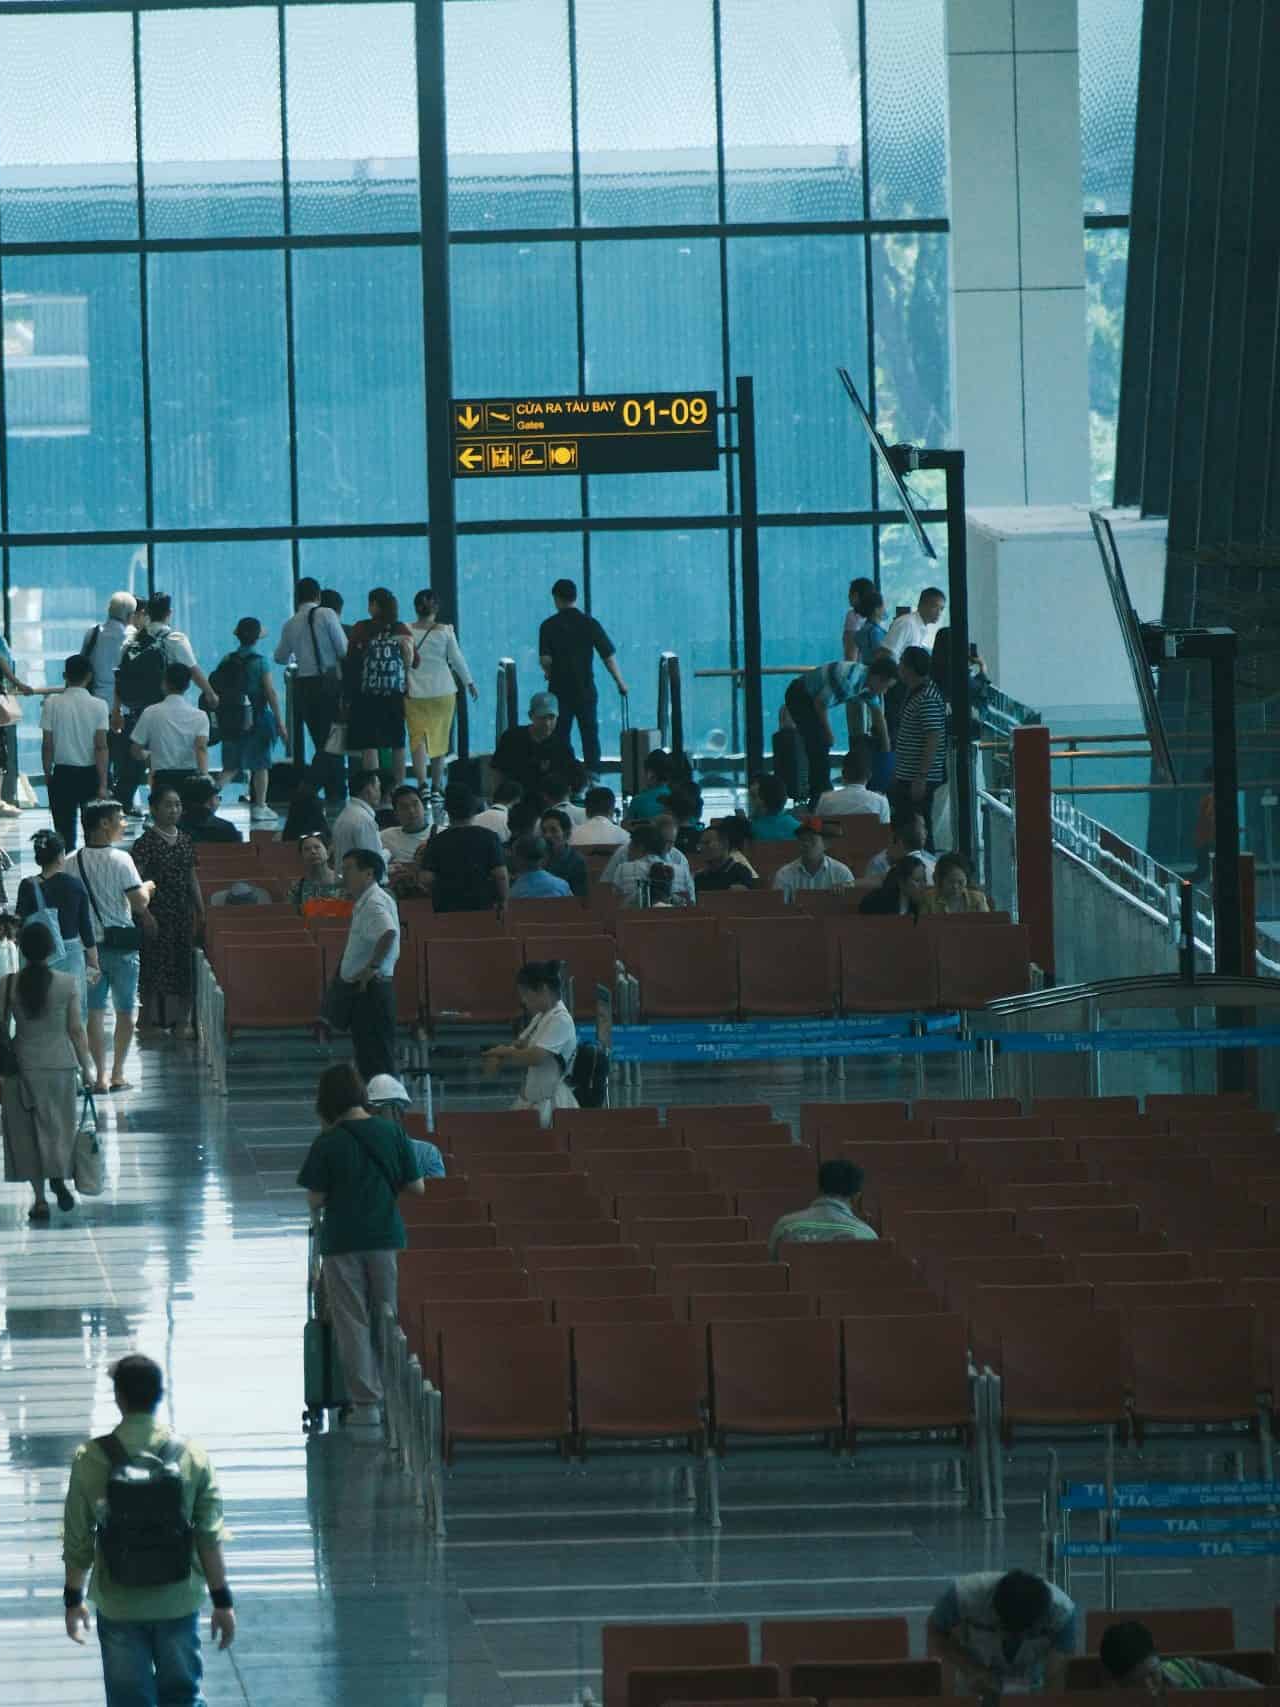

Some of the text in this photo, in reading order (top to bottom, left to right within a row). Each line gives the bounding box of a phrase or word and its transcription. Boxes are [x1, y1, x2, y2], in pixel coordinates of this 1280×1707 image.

[546, 402, 562, 414] RA
[565, 400, 589, 413] TÀU
[592, 400, 616, 412] BAY
[622, 398, 708, 426] 01-09
[1117, 1495, 1151, 1508] TIA
[1165, 1519, 1200, 1532] TIA
[1199, 1543, 1233, 1556] TIA
